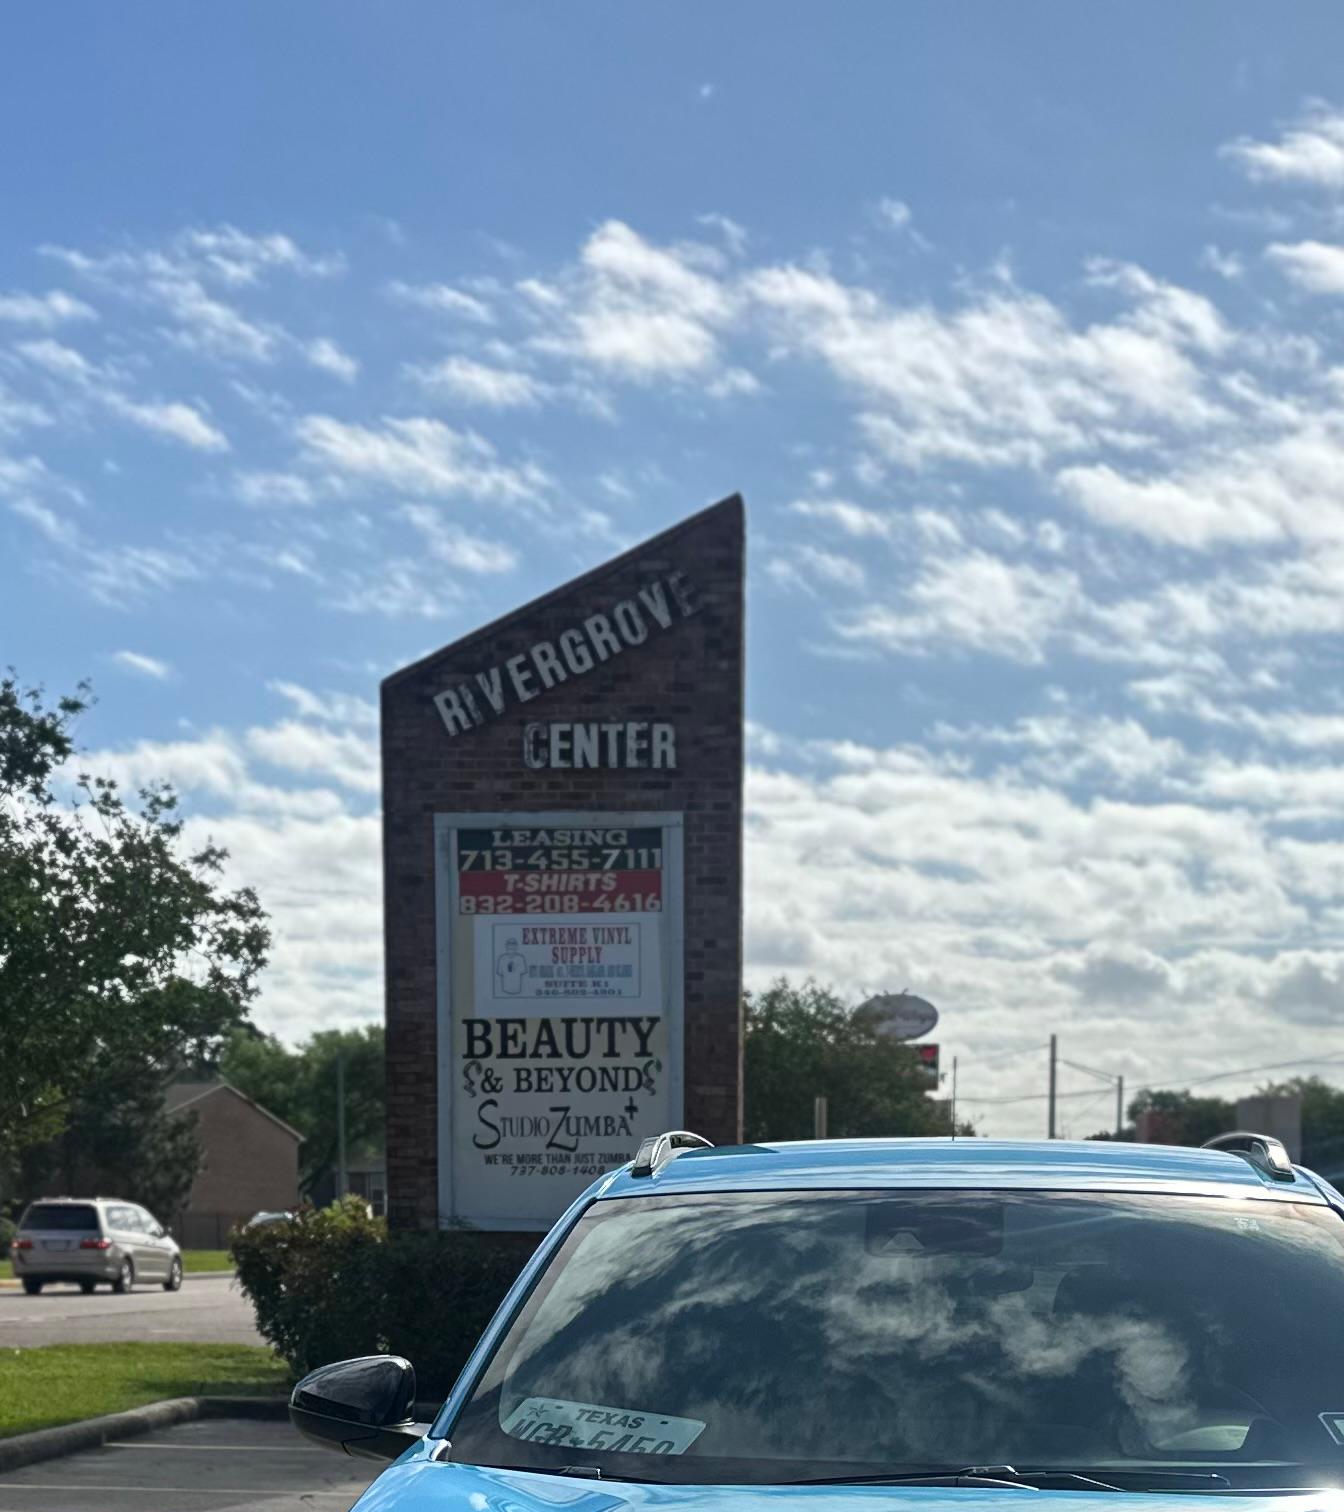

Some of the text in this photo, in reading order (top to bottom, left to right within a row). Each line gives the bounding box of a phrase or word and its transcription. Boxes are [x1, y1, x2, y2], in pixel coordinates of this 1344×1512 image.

[432, 570, 702, 737] RIVERGROVE
[523, 722, 677, 770] CENTER
[492, 829, 629, 848] LEASING
[459, 848, 662, 872] 713-455-7111
[504, 873, 618, 893] T-SHIRTS
[460, 893, 661, 914] 832-208-4616
[521, 927, 633, 945] EXTREME VINYL
[551, 946, 603, 965] SUPPLY
[462, 1016, 661, 1060] BEAUTY
[480, 1066, 644, 1094] & BEYOND
[516, 1154, 543, 1165] MORE
[546, 1153, 572, 1164] THAN
[574, 1153, 596, 1164] JUST
[598, 1152, 632, 1164] ZUMBA
[576, 1408, 646, 1429] TEXAS
